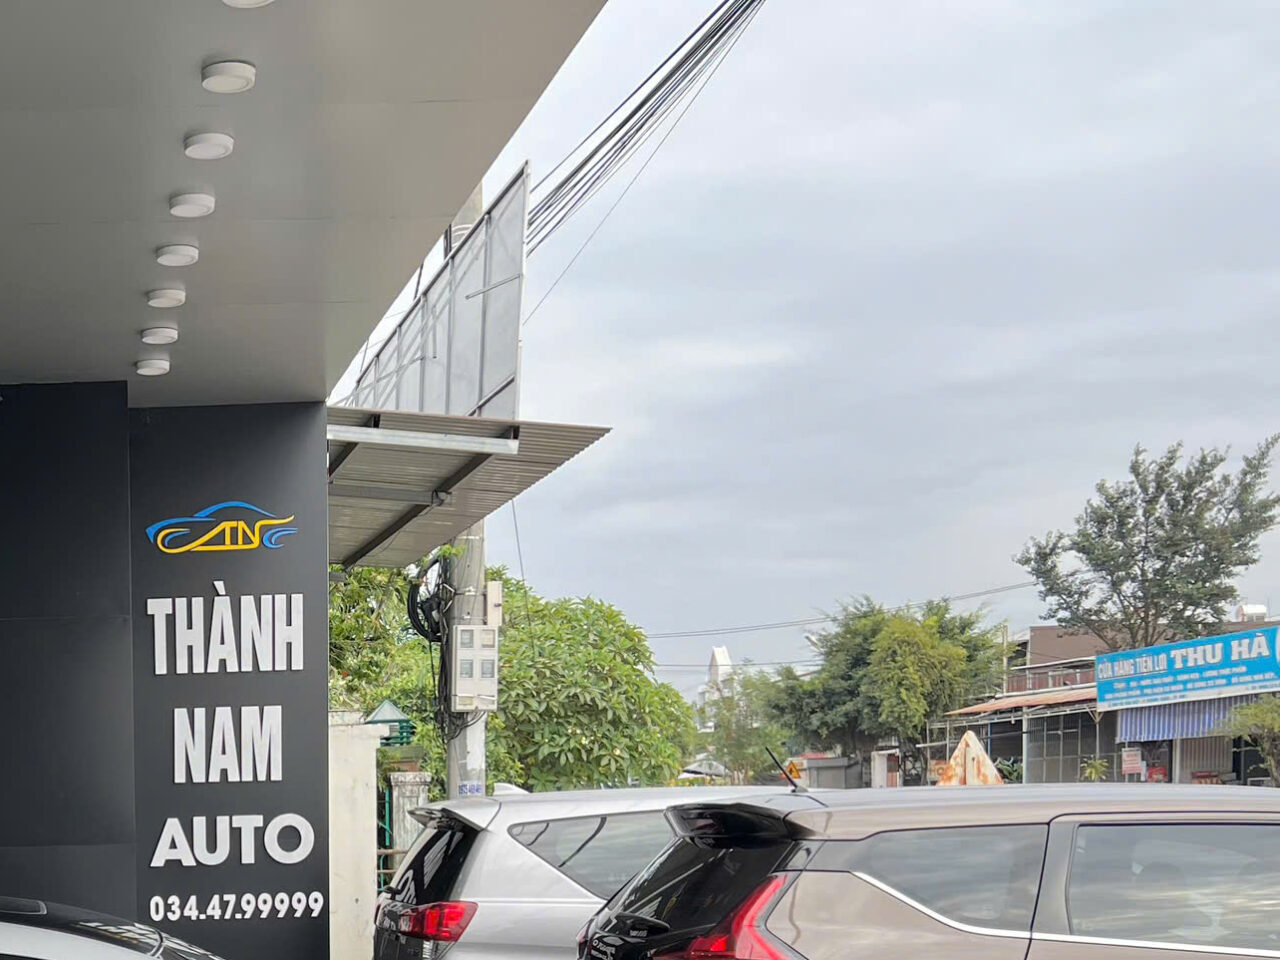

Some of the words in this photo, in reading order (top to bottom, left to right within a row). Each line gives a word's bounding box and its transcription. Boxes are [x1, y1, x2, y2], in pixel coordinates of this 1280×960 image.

[147, 580, 304, 675] THÀNH
[1170, 642, 1223, 669] THU
[1231, 632, 1270, 661] HÀ
[173, 705, 283, 784] NAM
[150, 812, 315, 868] AUTO
[149, 891, 324, 922] 034.47.99999
